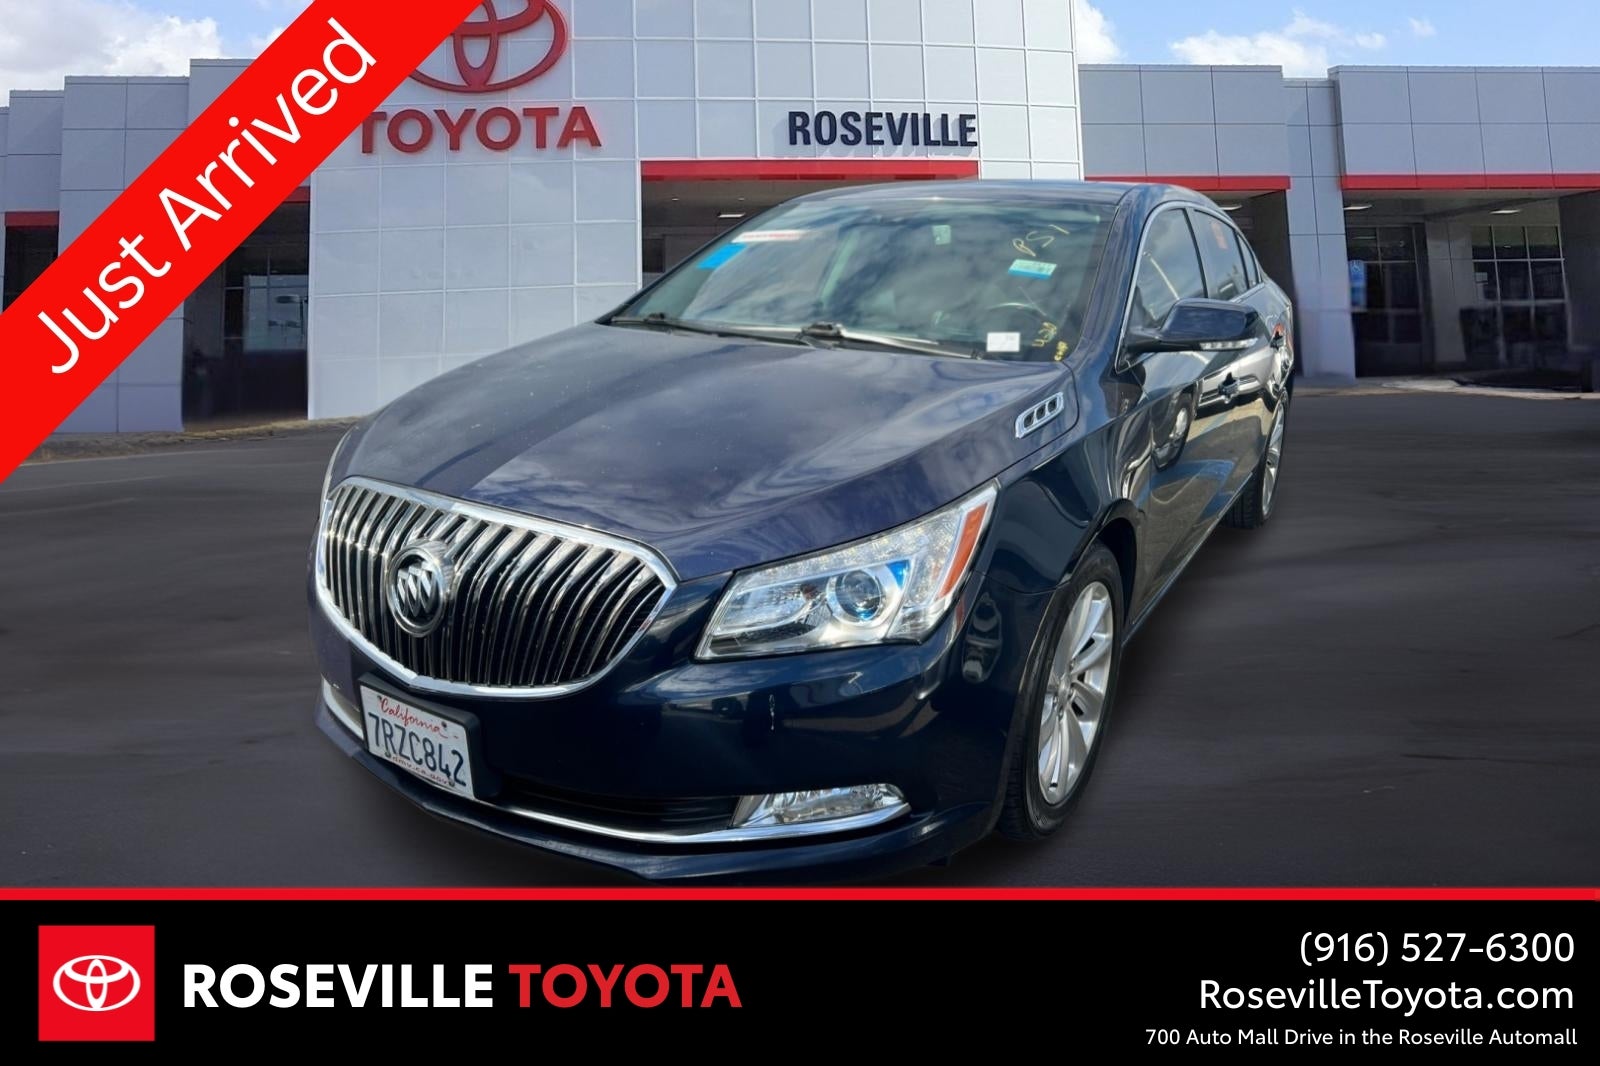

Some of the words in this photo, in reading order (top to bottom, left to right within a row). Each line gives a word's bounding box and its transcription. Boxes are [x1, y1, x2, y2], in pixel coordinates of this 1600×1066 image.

[361, 106, 602, 154] TOYOTA
[788, 110, 978, 147] ROSEVILLE
[379, 697, 449, 739] California
[368, 711, 467, 787] 7RZC842
